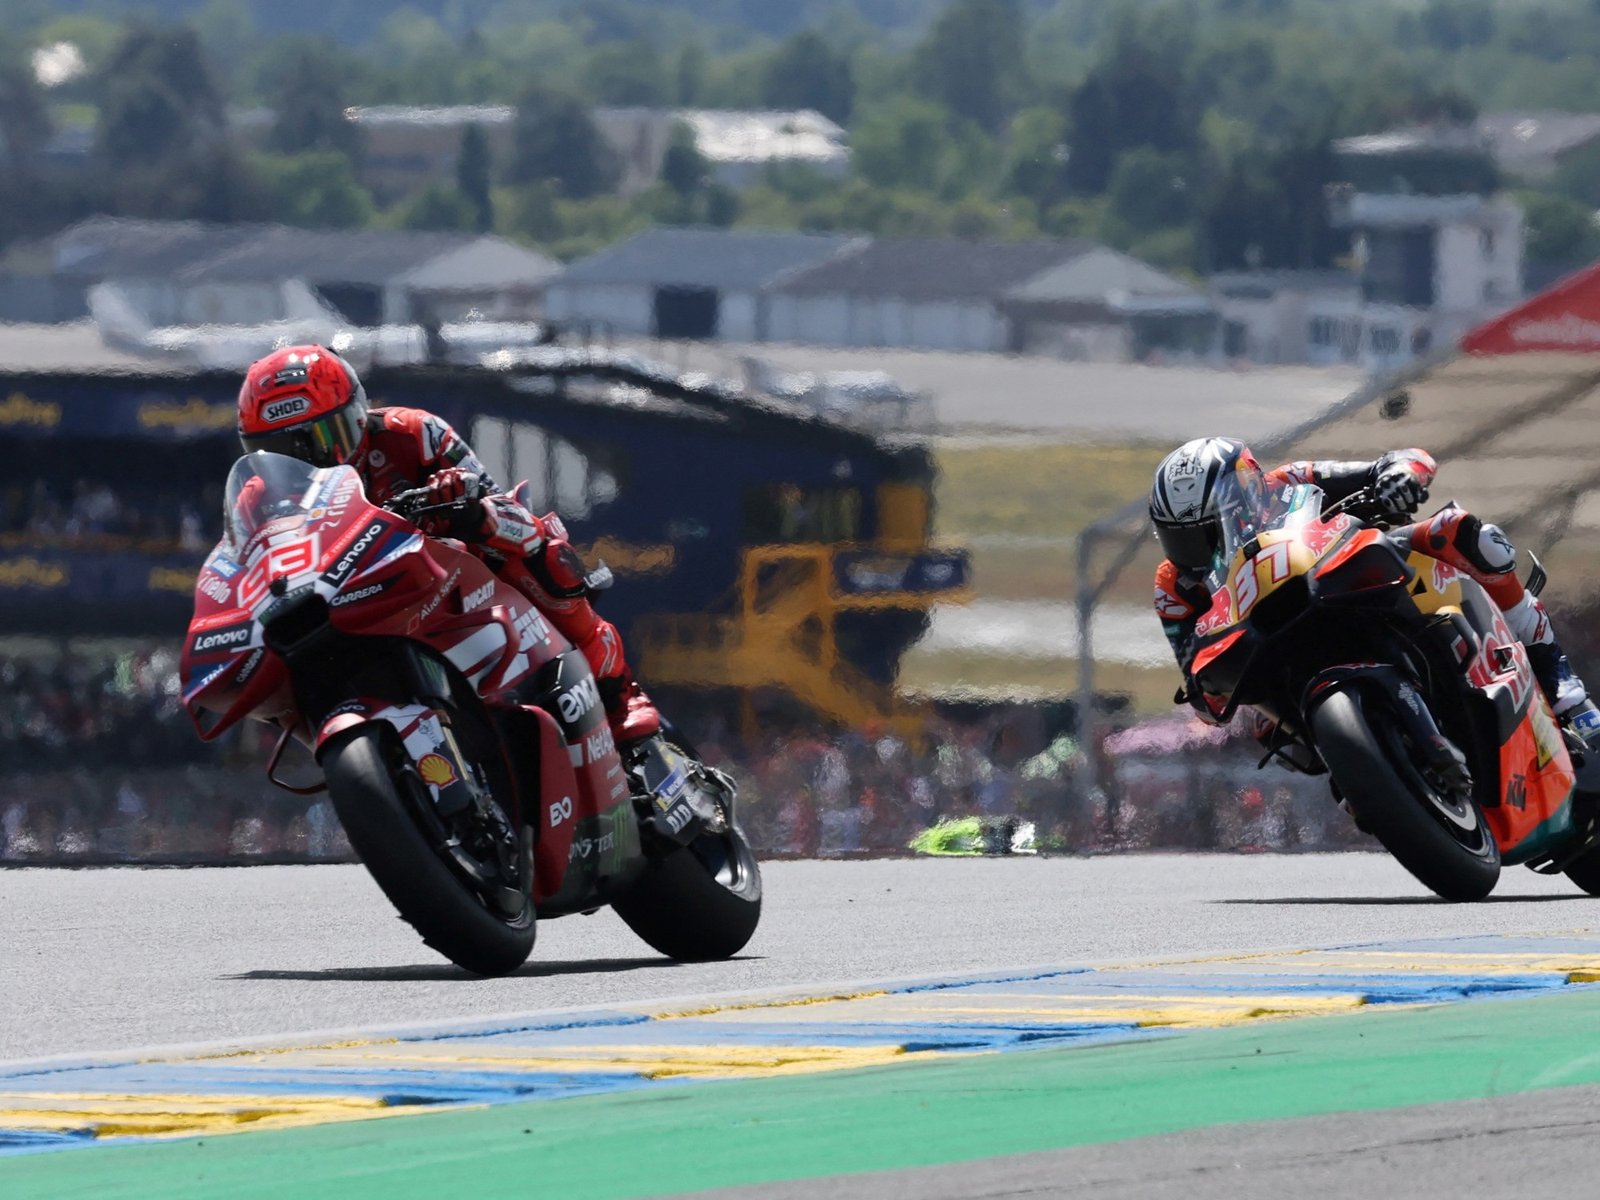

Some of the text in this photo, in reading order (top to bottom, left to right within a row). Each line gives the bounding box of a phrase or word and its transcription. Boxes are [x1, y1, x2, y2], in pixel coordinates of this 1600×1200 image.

[266, 399, 305, 419] SHOEI
[326, 523, 383, 580] Lenovo
[331, 583, 383, 606] CARRERA
[419, 567, 462, 620] Audi Sport
[463, 579, 495, 613] DUCATI
[1234, 540, 1294, 619] 37
[194, 628, 249, 651] Lenovo
